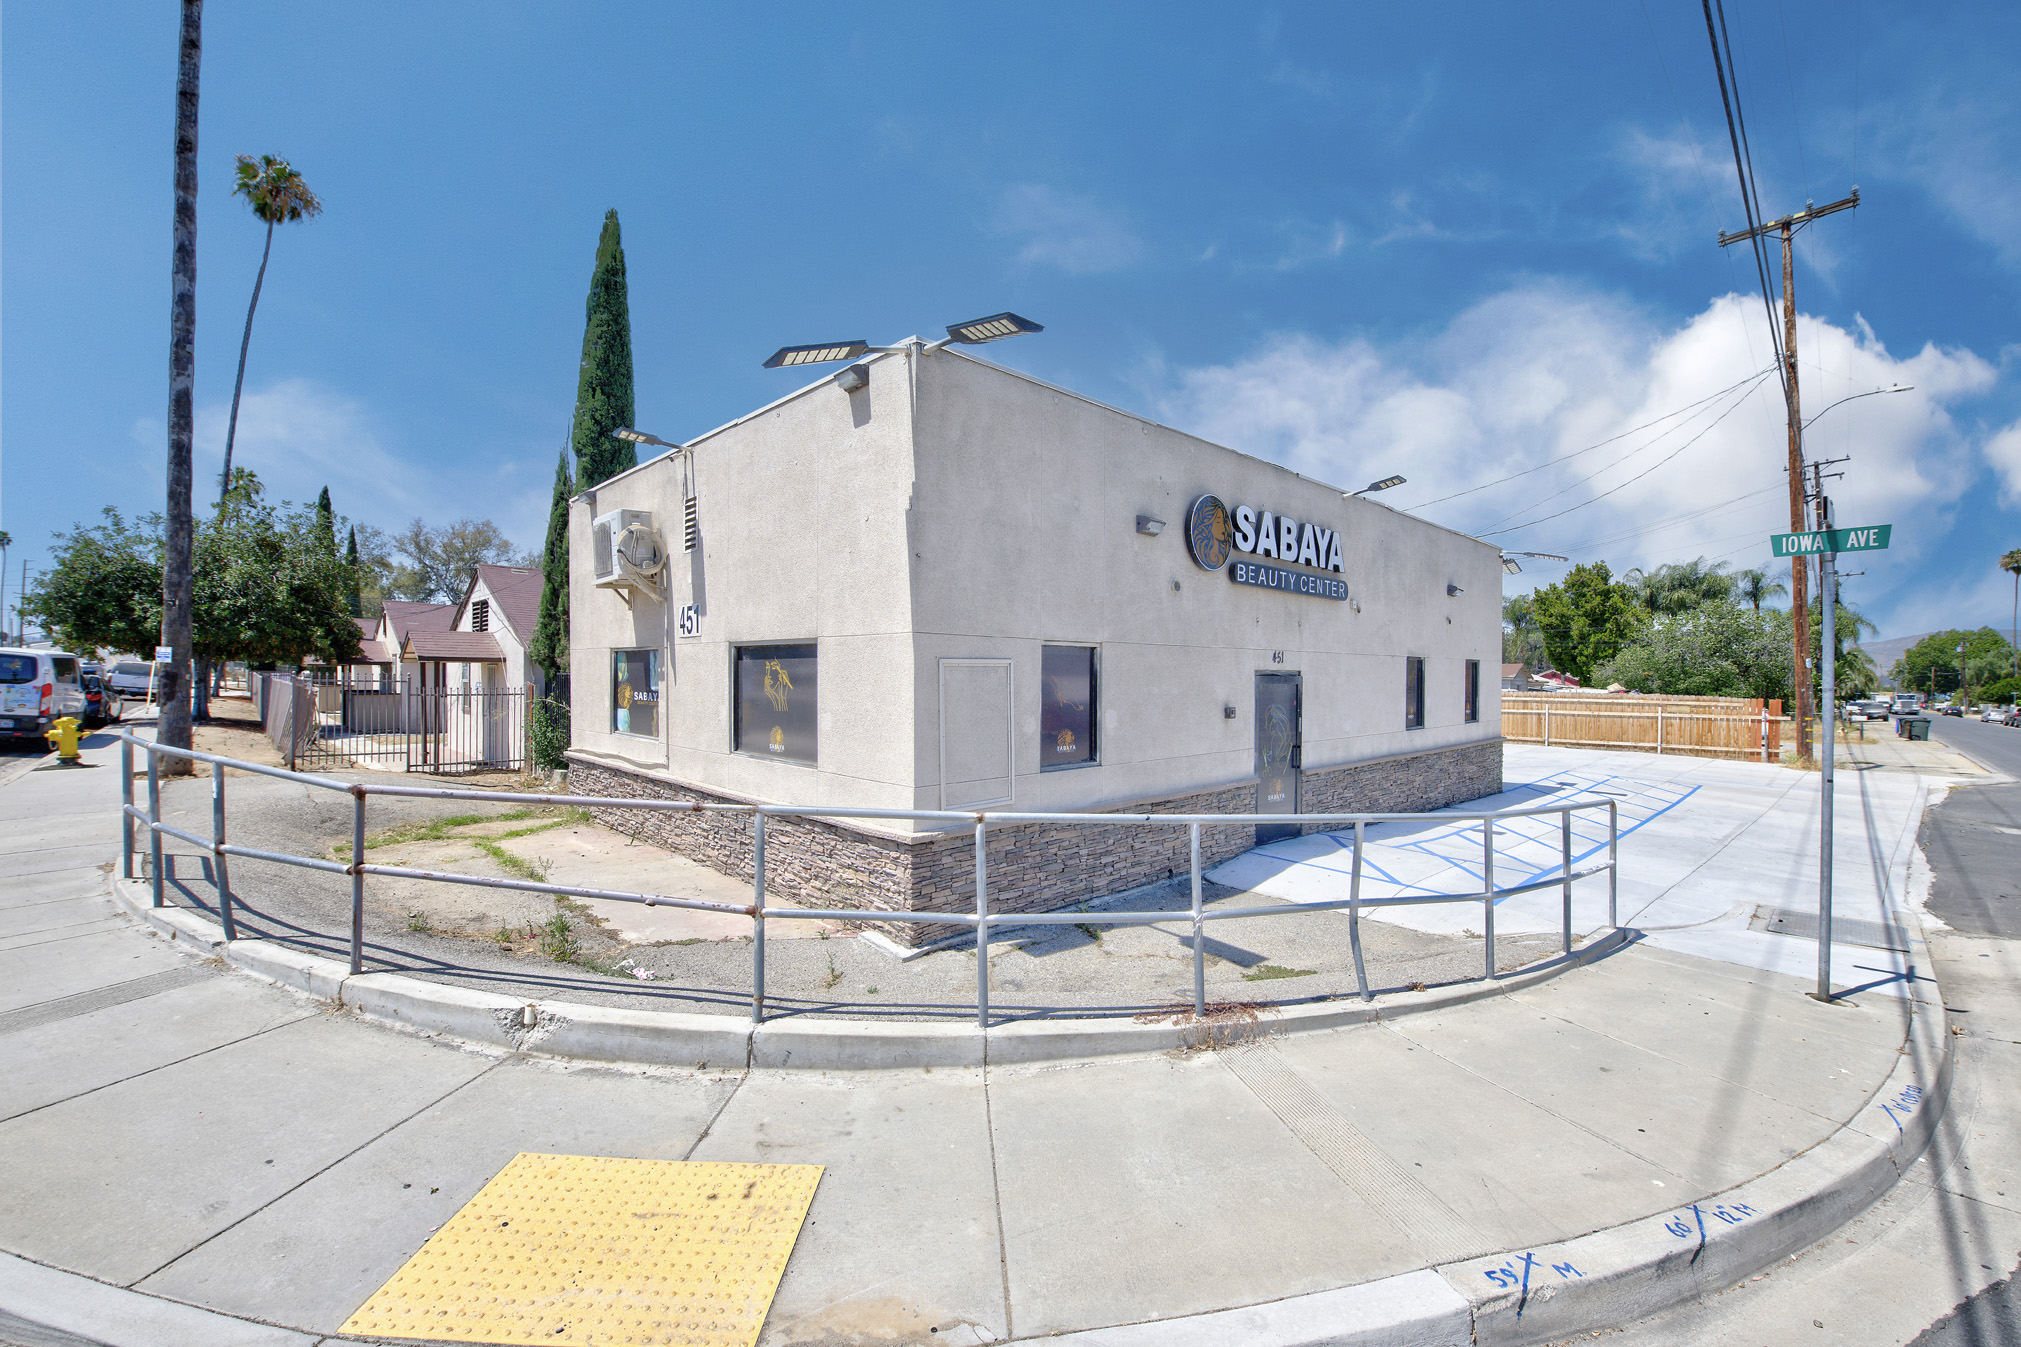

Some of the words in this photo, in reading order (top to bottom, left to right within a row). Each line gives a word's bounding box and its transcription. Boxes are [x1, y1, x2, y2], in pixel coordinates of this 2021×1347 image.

[1233, 504, 1345, 573] SABAYA
[1782, 534, 1824, 554] IOWA
[1846, 529, 1879, 548] AVE
[1237, 563, 1297, 590] BEAUTY
[1300, 575, 1345, 598] CENTER
[679, 604, 699, 635] 451
[1272, 650, 1284, 664] 451
[633, 691, 660, 702] SABAY
